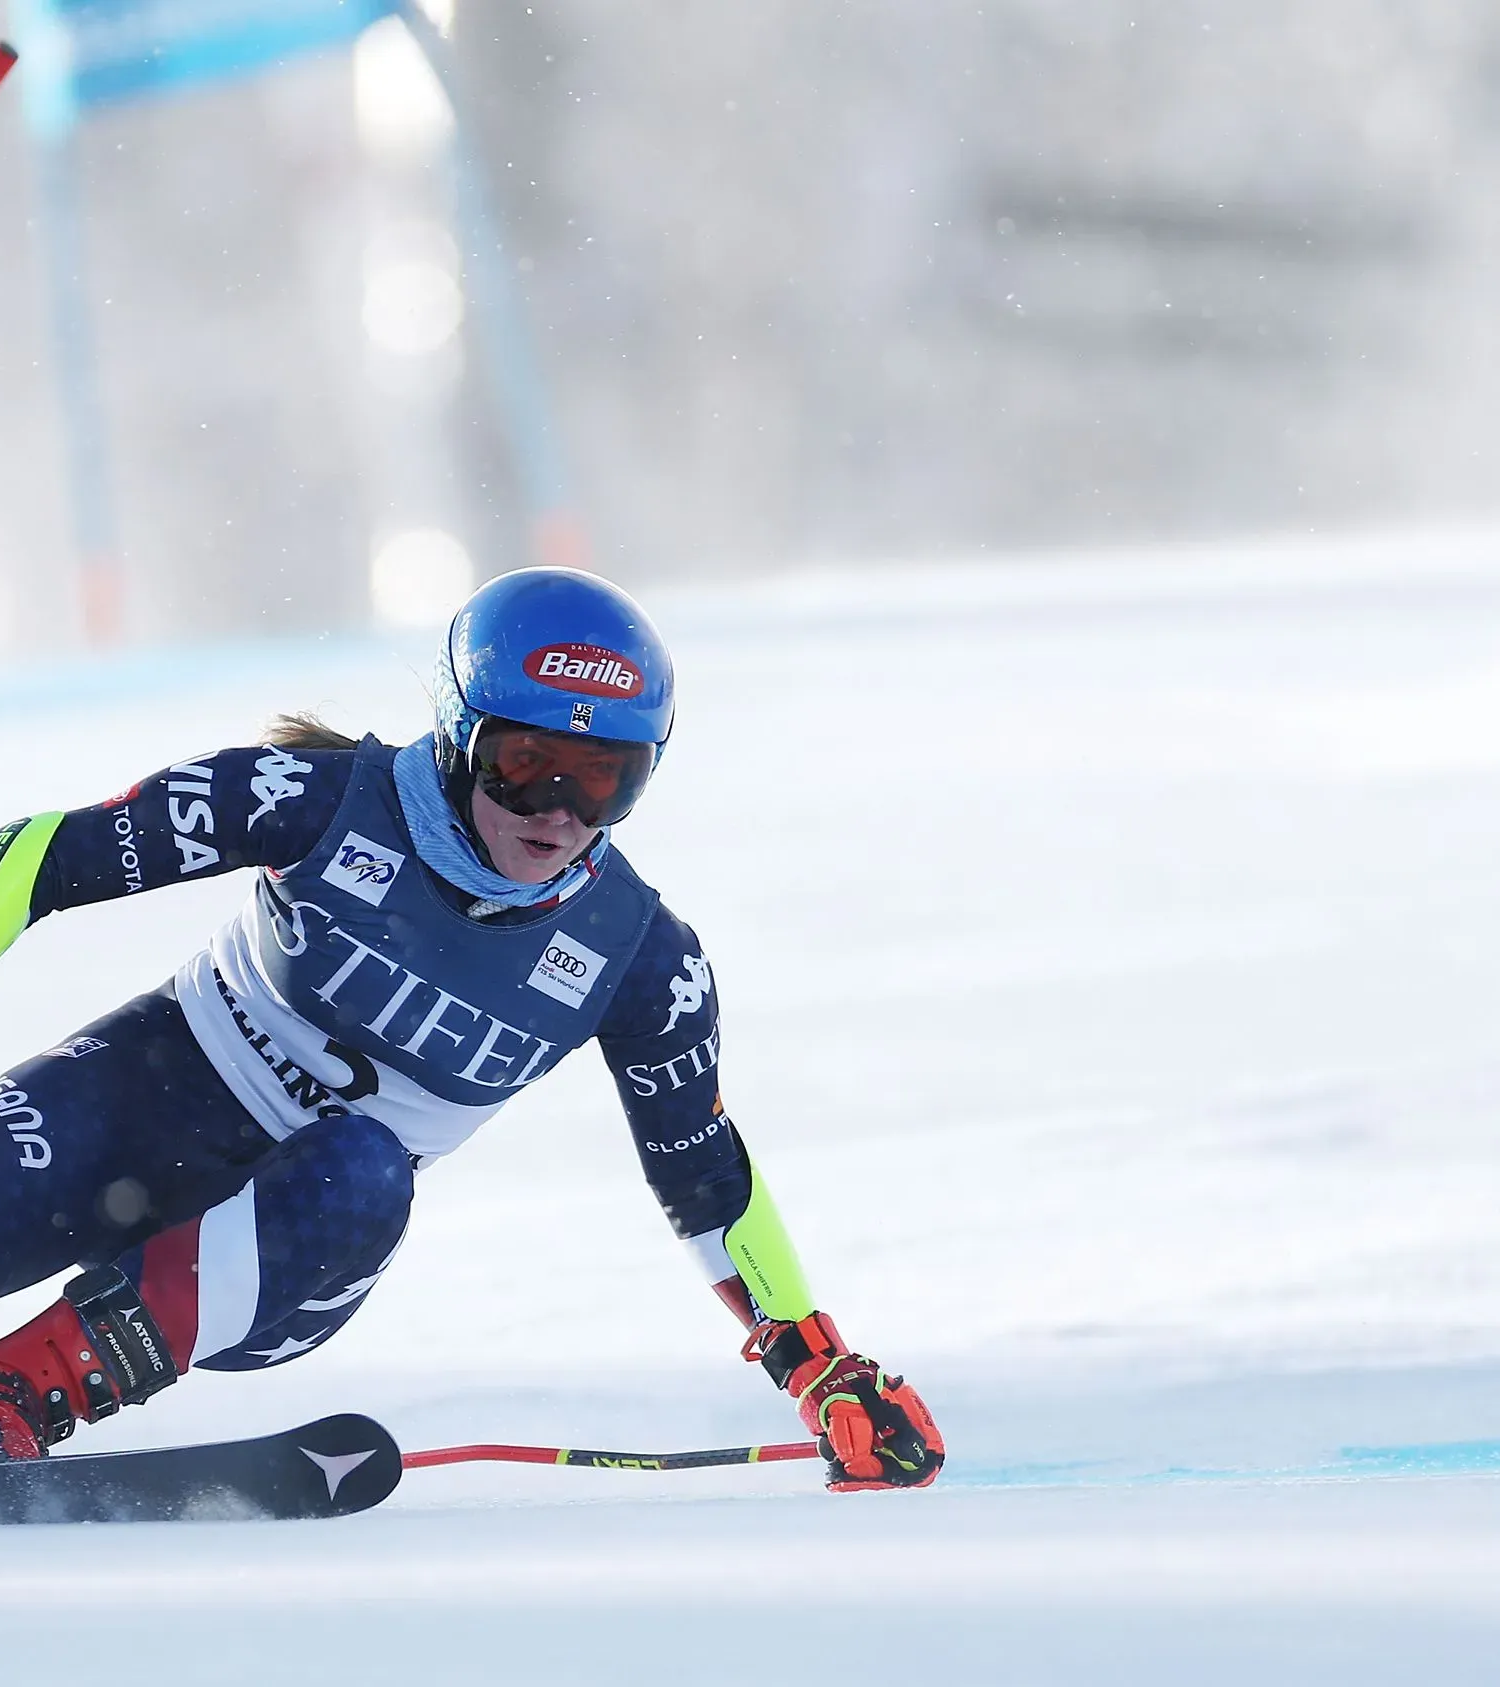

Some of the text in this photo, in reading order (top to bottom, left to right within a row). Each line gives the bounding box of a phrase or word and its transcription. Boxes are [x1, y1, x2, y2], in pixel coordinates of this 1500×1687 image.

[538, 652, 635, 690] Barilla
[571, 644, 611, 656] DAL 1877
[574, 704, 593, 715] US
[168, 751, 220, 875] VISA
[113, 805, 143, 893] TOYOTA
[537, 967, 548, 976] FIS
[547, 973, 557, 981] Ski
[557, 978, 574, 990] World
[541, 963, 555, 972] Audi
[625, 1014, 721, 1097] STIF
[741, 1244, 758, 1271] MIKAELA
[755, 1270, 773, 1297] SHIFFRIN
[106, 1332, 137, 1388] PROFESSIONAL
[131, 1321, 164, 1372] ATOMIC
[823, 1369, 874, 1393] LEKI
